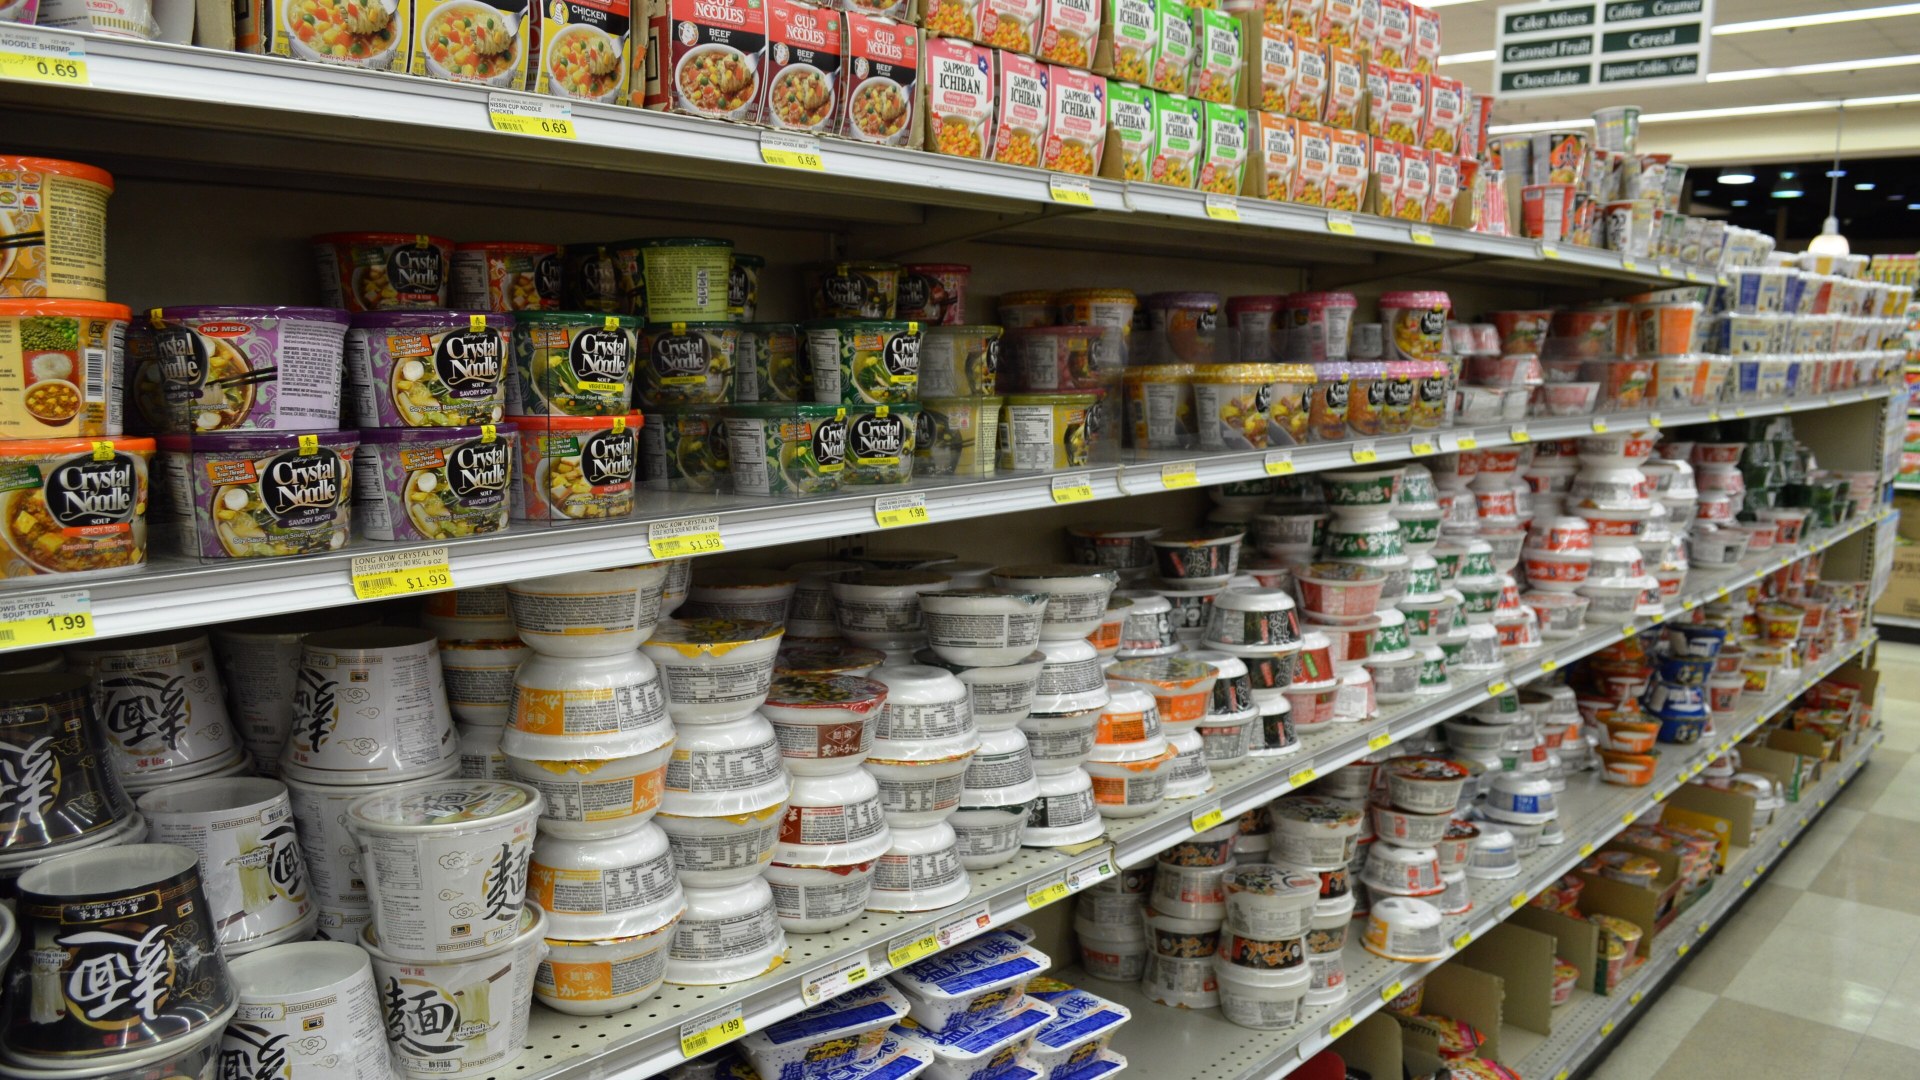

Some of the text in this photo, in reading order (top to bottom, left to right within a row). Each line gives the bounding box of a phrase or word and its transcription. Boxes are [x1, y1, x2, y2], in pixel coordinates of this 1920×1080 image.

[571, 5, 607, 21] CHICKEN
[695, 4, 745, 24] NOODLES
[1122, 0, 1145, 13] SAPPORO
[1607, 5, 1644, 20] Coffee
[794, 15, 817, 30] CUP
[1120, 9, 1149, 29] ICHIBAN
[1169, 17, 1185, 31] SAPPORO
[1513, 12, 1587, 32] Cake Mixes
[709, 28, 731, 37] BEEF
[786, 24, 825, 45] NOODLES
[875, 30, 895, 43] CUP
[1167, 26, 1188, 45] ICHIBAN
[1213, 29, 1232, 42] SAPPORO
[1628, 29, 1676, 49] Cereal
[2, 39, 70, 52] NOODLE SHRIMP
[797, 49, 814, 57] BEEF
[867, 40, 902, 60] NOODLES
[1211, 38, 1235, 56] ICHIBAN
[1507, 40, 1590, 61] Canned Fruit
[1264, 50, 1289, 66] ICHIBAN
[37, 62, 77, 78] 0.69
[877, 63, 892, 71] BEEF
[943, 61, 974, 77] SAPPORO
[940, 73, 980, 95] ICHIBAN
[1014, 76, 1037, 91] SAPPORO
[1513, 71, 1579, 89] Chocolate
[1011, 88, 1041, 108] ICHIBAN
[1065, 89, 1091, 104] SAPPORO
[1390, 92, 1416, 105] ICHIBAN
[1061, 100, 1096, 120] ICHIBAN
[1118, 102, 1141, 115] SAPPORO
[542, 122, 566, 133] 0.69
[1115, 113, 1146, 129] ICHIBAN
[1168, 114, 1189, 125] SAPPORO
[1166, 124, 1194, 138] ICHIBAN
[1218, 123, 1236, 134] SAPPORO
[1215, 133, 1240, 147] ICHIBAN
[798, 156, 816, 166] 0.69
[395, 252, 439, 273] Crystal
[398, 268, 439, 288] Noodle
[447, 337, 498, 363] Crystal
[581, 334, 627, 357] Crystal
[658, 339, 703, 357] Crystal
[449, 357, 498, 382] Noodle
[578, 354, 626, 376] Noodle
[661, 354, 703, 370] Noodle
[857, 420, 900, 438] Crystal
[591, 437, 632, 461] Crystal
[858, 436, 899, 452] Noodle
[458, 445, 505, 473] Crystal
[273, 458, 335, 491] Crystal
[591, 456, 632, 479] Noodle
[60, 464, 130, 495] Crystal
[234, 474, 255, 482] Noodles
[459, 464, 504, 492] Noodle
[61, 487, 130, 517] Noodle
[276, 480, 337, 510] Noodle
[303, 508, 320, 516] SOUP
[909, 508, 924, 518] 1.99
[288, 514, 330, 527] SAVORY SHOYU
[105, 525, 119, 533] TOFU
[233, 537, 246, 545] Soy
[269, 533, 289, 541] Based
[290, 531, 306, 539] Soup
[690, 539, 720, 550] $1.99
[355, 557, 376, 565] LONG
[398, 550, 430, 559] CRYSTAL
[368, 562, 386, 571] SAVORY
[407, 573, 447, 589] $1.99
[18, 602, 55, 610] CRYSTAL
[48, 615, 85, 631] 1.99
[242, 855, 266, 864] Fresh
[1052, 885, 1065, 895] 1.99
[112, 896, 146, 906] SEAFOOD
[918, 938, 933, 950] 1.99
[461, 1023, 486, 1032] Fresh
[721, 1019, 739, 1034] 1.99
